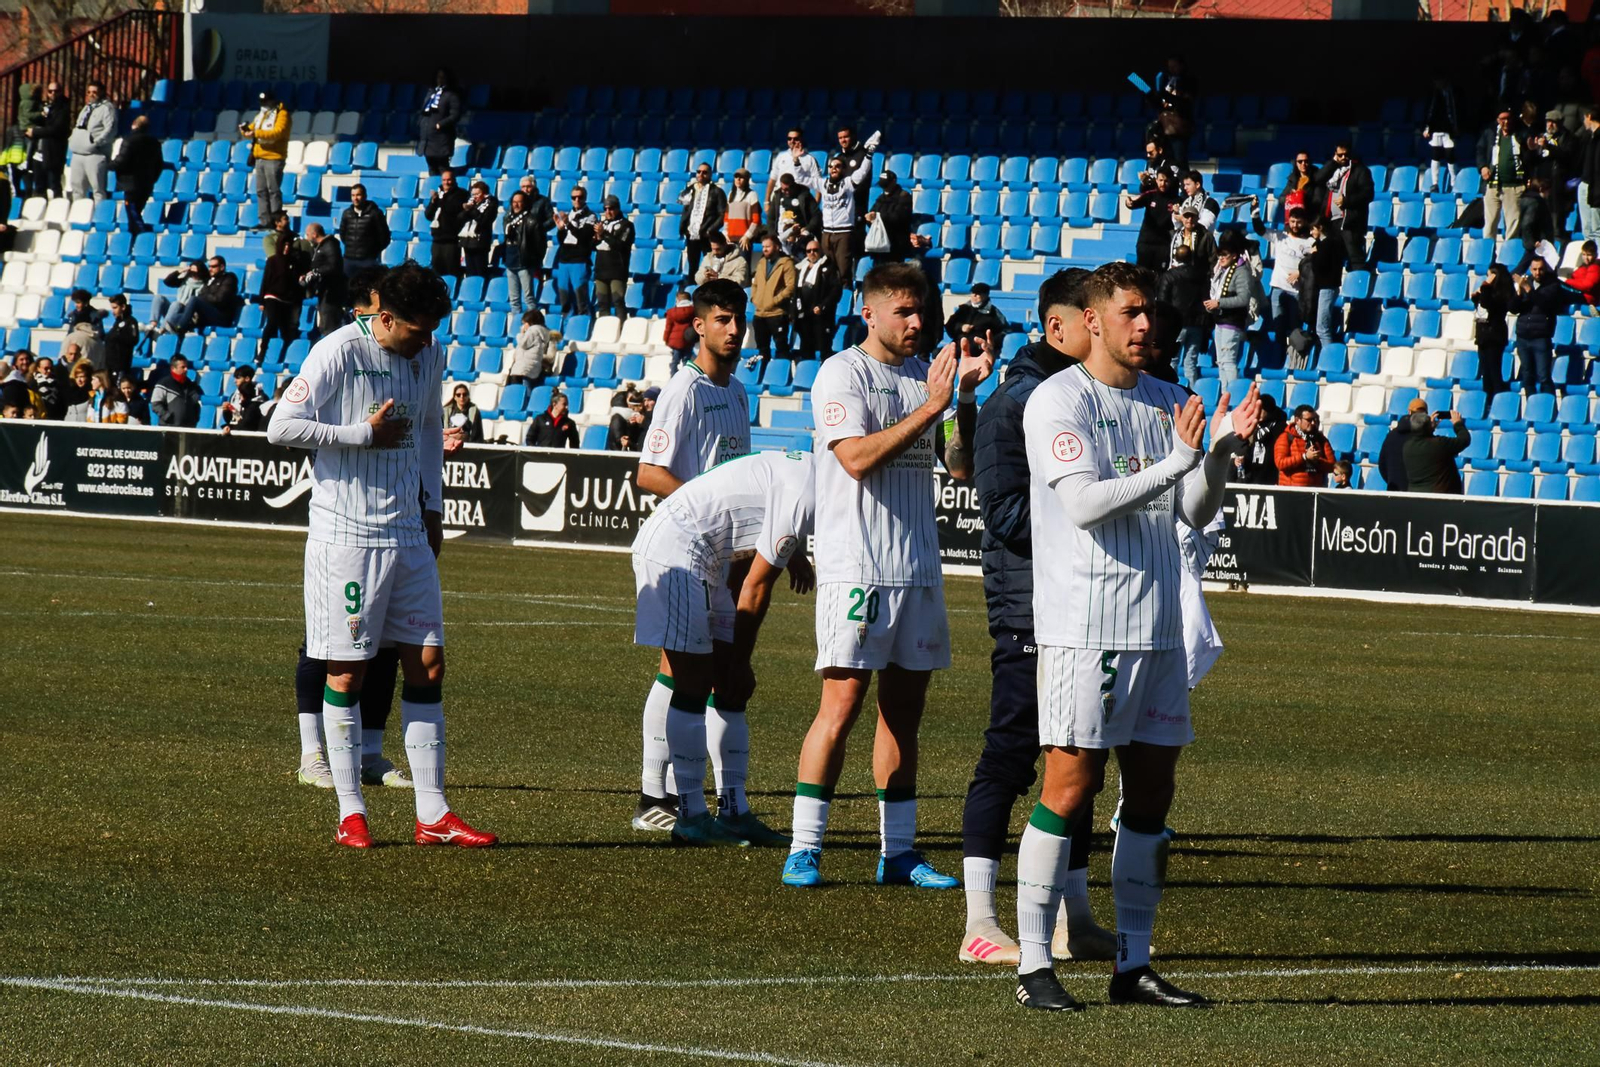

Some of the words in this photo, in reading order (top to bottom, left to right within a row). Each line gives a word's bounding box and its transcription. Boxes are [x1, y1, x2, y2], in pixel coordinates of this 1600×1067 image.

[236, 48, 278, 62] GRADA
[235, 64, 318, 80] PANELAIS
[76, 447, 89, 457] SAT
[89, 448, 113, 459] OFICIAL
[113, 449, 125, 459] DE
[124, 450, 158, 460] CALDERAS
[87, 463, 105, 478] 923
[106, 464, 126, 479] 265
[126, 465, 144, 480] 194
[165, 454, 314, 487] AQUATHERAPIA
[442, 461, 491, 489] NERA
[77, 482, 154, 496] www.electroclisa.es
[165, 485, 189, 497] SPA
[197, 487, 250, 501] CENTER
[442, 498, 486, 526] RRA
[569, 511, 630, 529] CLÍNICA
[1321, 517, 1397, 554] Mesón
[1406, 521, 1434, 557] La
[1442, 523, 1527, 562] Parada
[344, 581, 361, 615] 9
[847, 587, 881, 625] 20
[1101, 649, 1118, 691] 5
